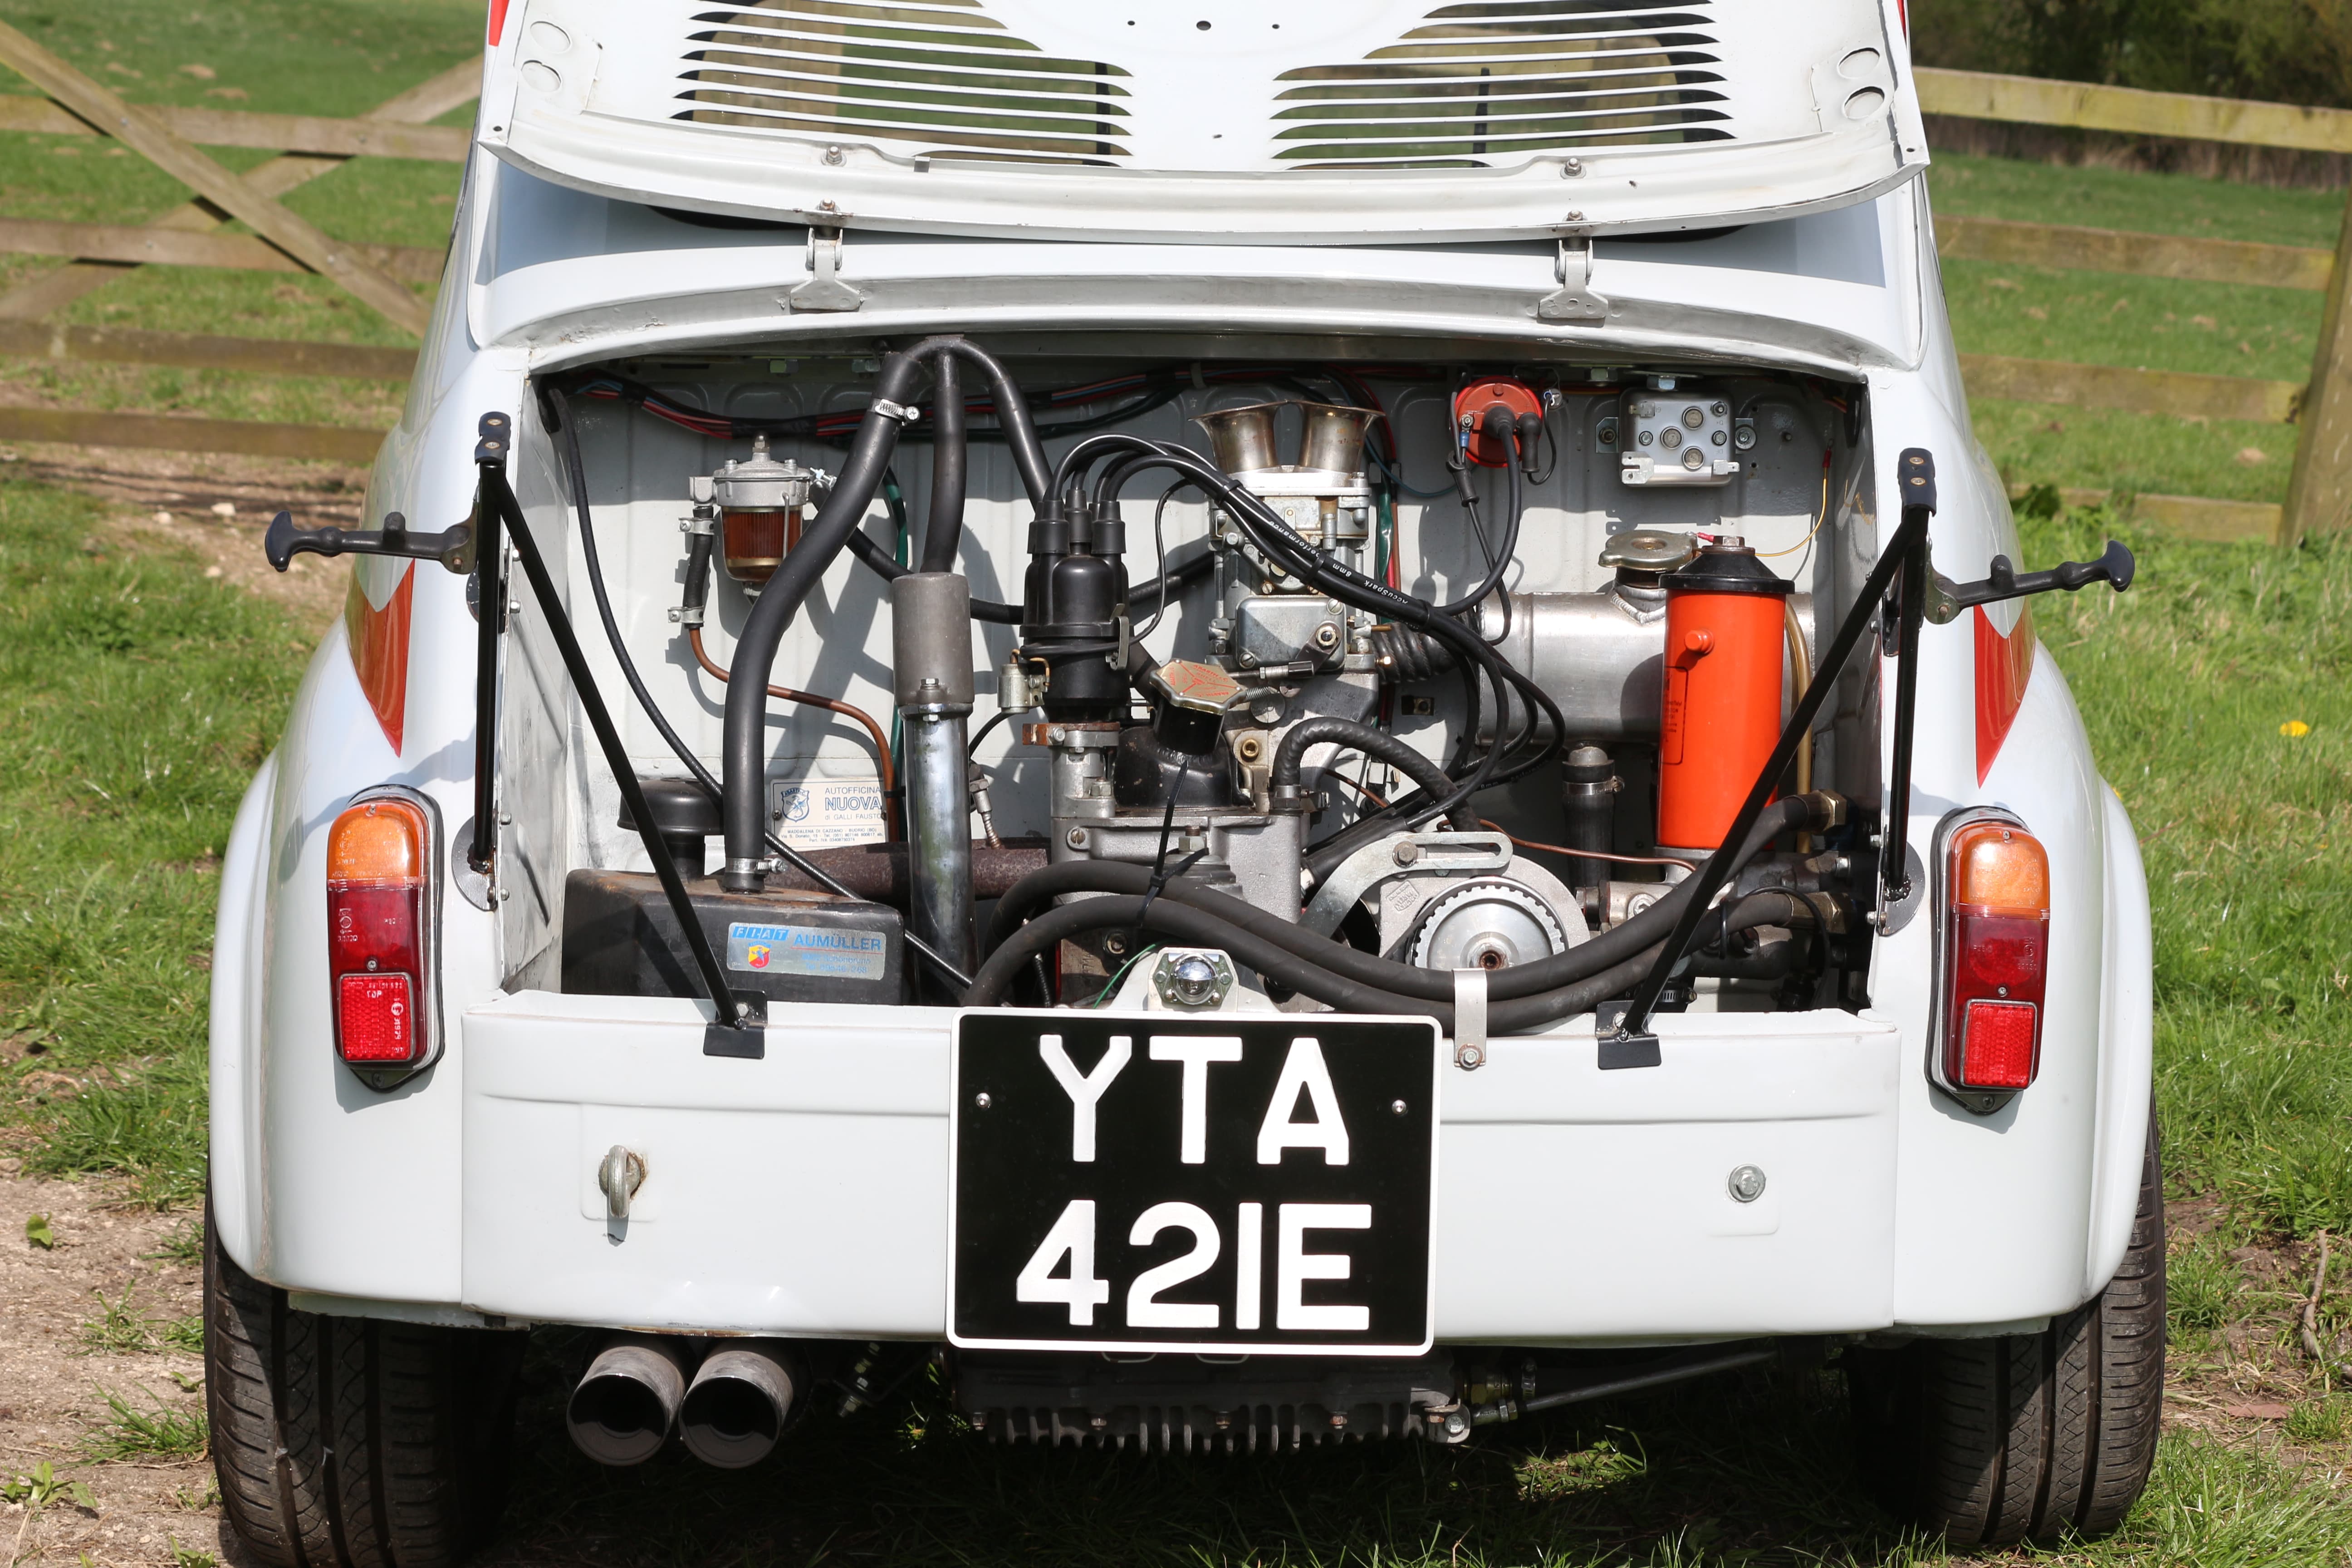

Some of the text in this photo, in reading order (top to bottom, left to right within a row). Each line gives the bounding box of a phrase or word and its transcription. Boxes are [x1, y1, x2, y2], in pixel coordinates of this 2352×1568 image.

[1333, 562, 1352, 578] 8mm
[1364, 579, 1408, 604] AccuSpark
[825, 786, 881, 794] AUTOFFICINA
[824, 796, 881, 811] NUOVA
[733, 926, 789, 940] FIAT
[793, 933, 881, 951] AUMÜLLER
[1039, 1034, 1350, 1166] YTA
[1016, 1199, 1372, 1331] 421E
